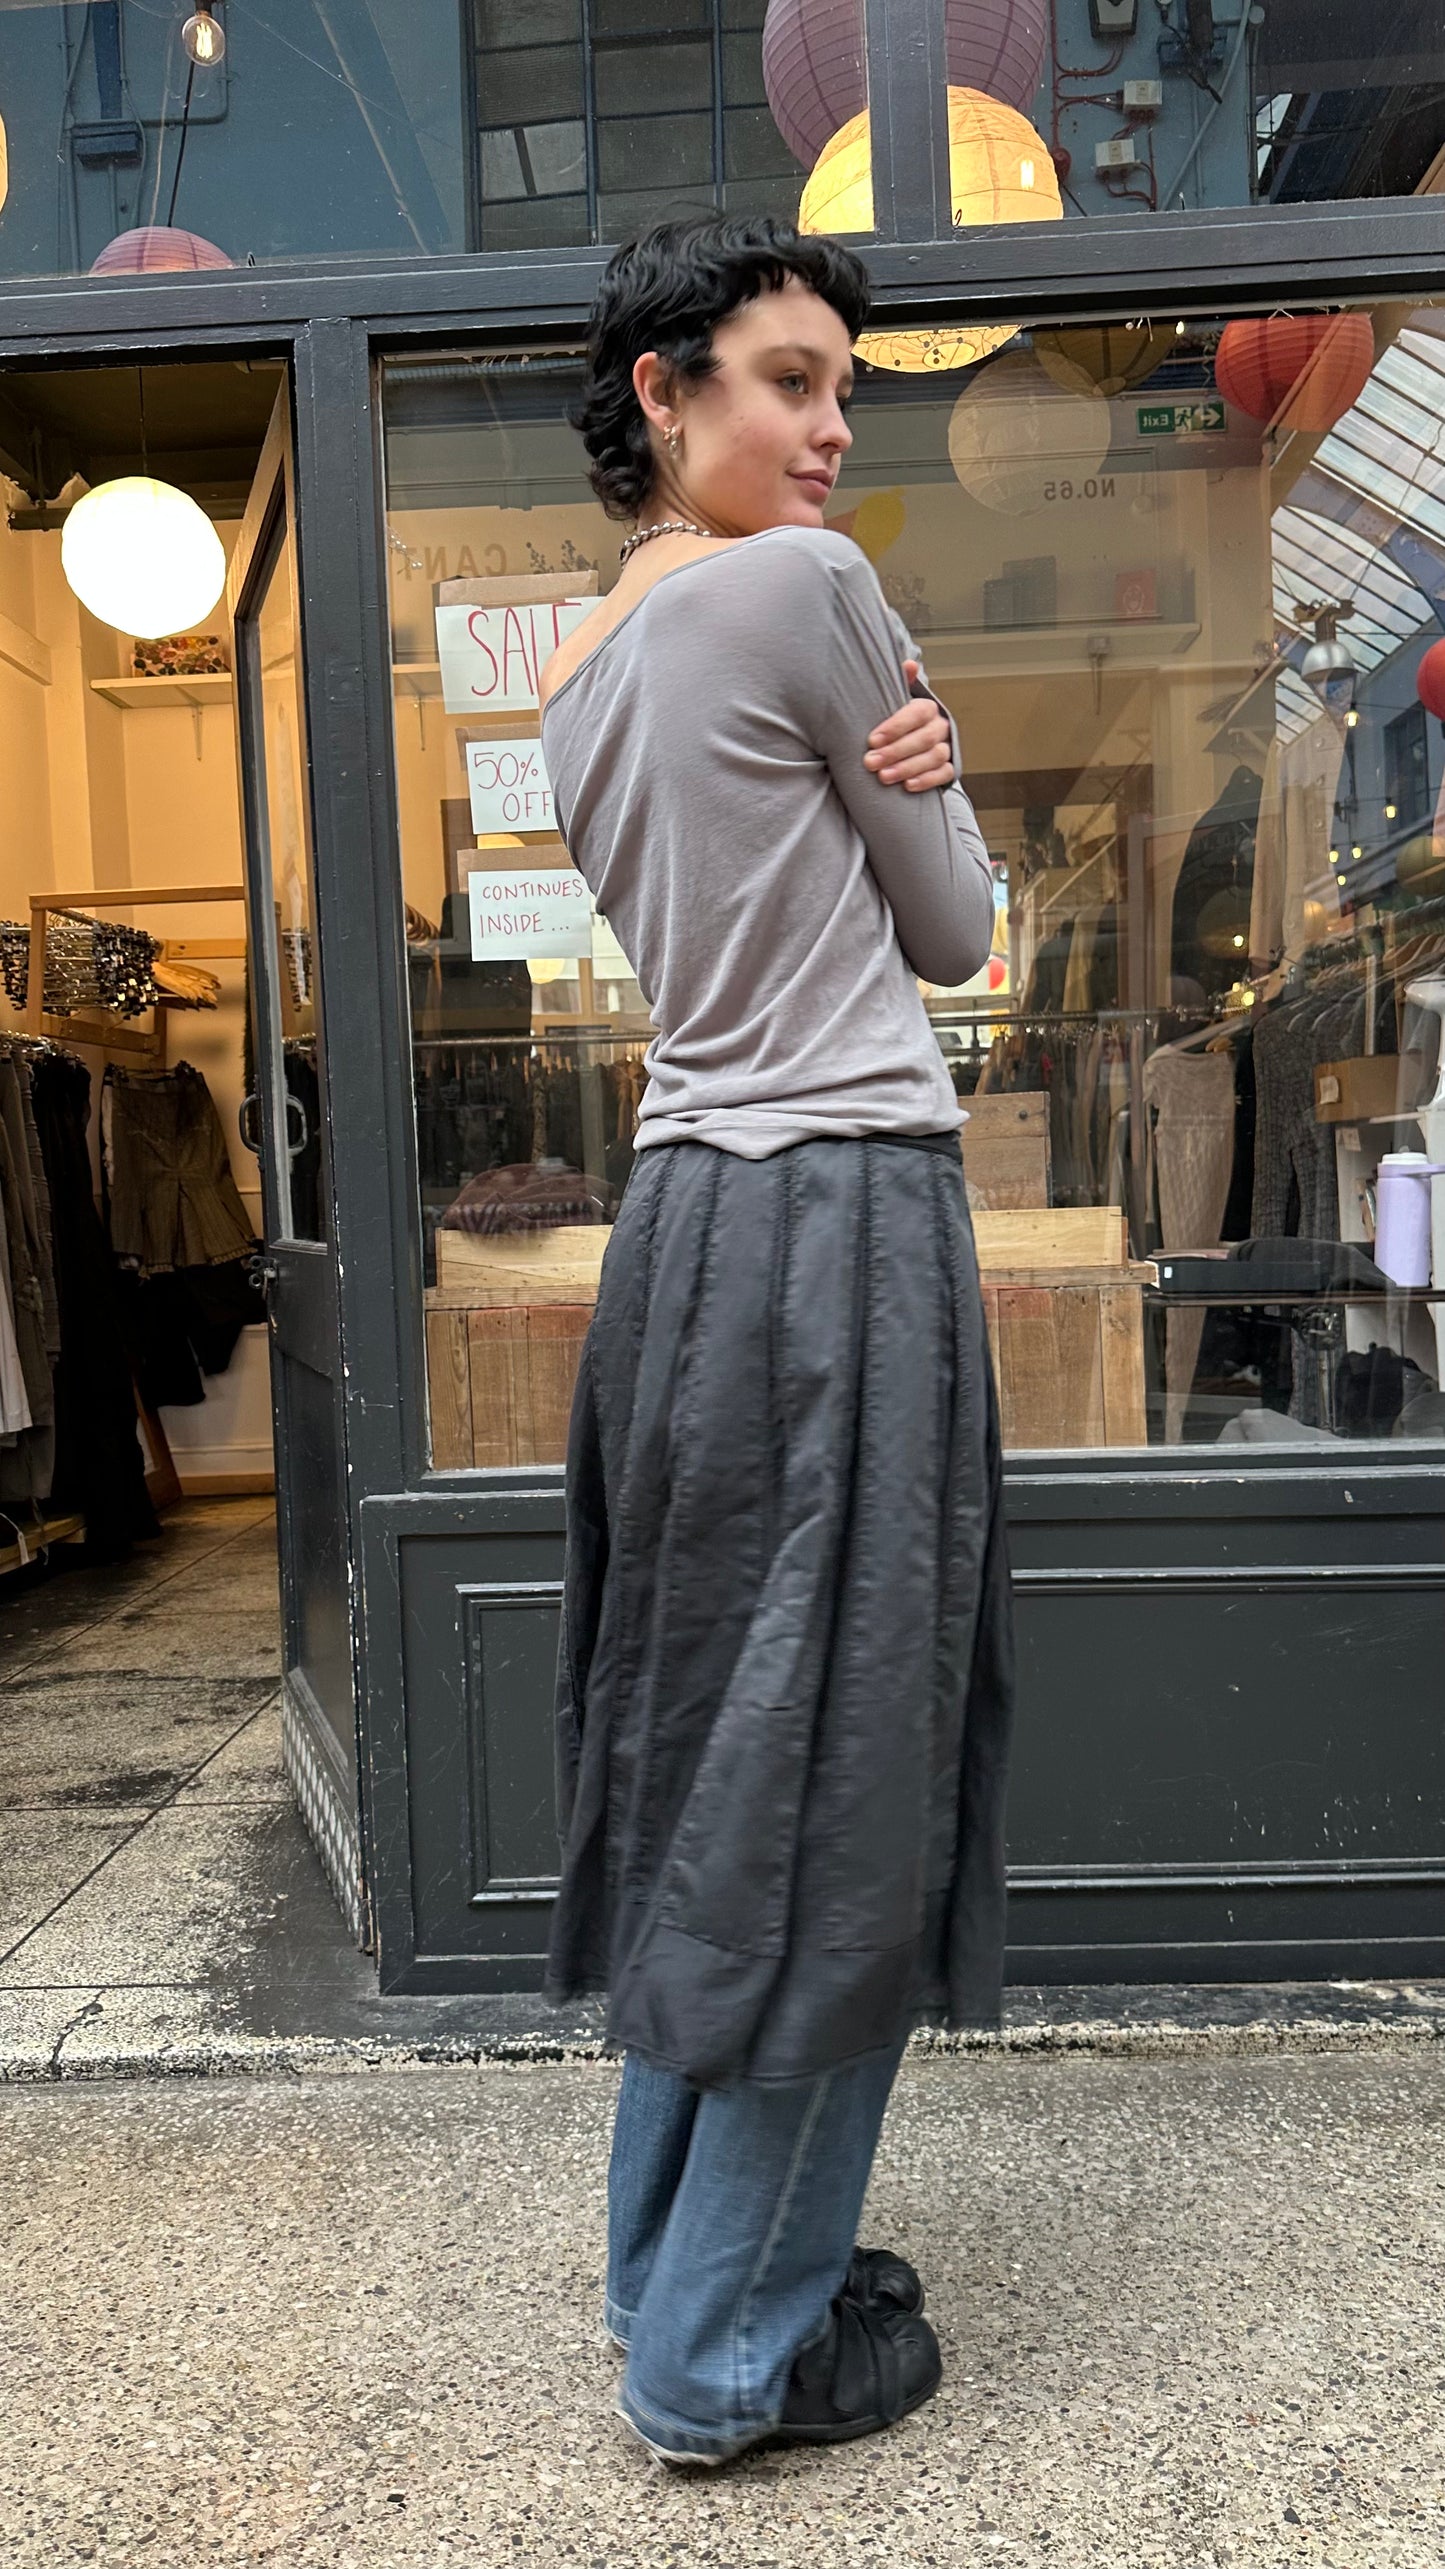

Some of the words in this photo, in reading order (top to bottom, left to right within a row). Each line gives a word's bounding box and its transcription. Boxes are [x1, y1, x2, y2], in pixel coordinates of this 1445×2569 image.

[474, 752, 538, 790] 50%
[502, 790, 552, 822] OFF
[482, 878, 584, 901] CONTINUES
